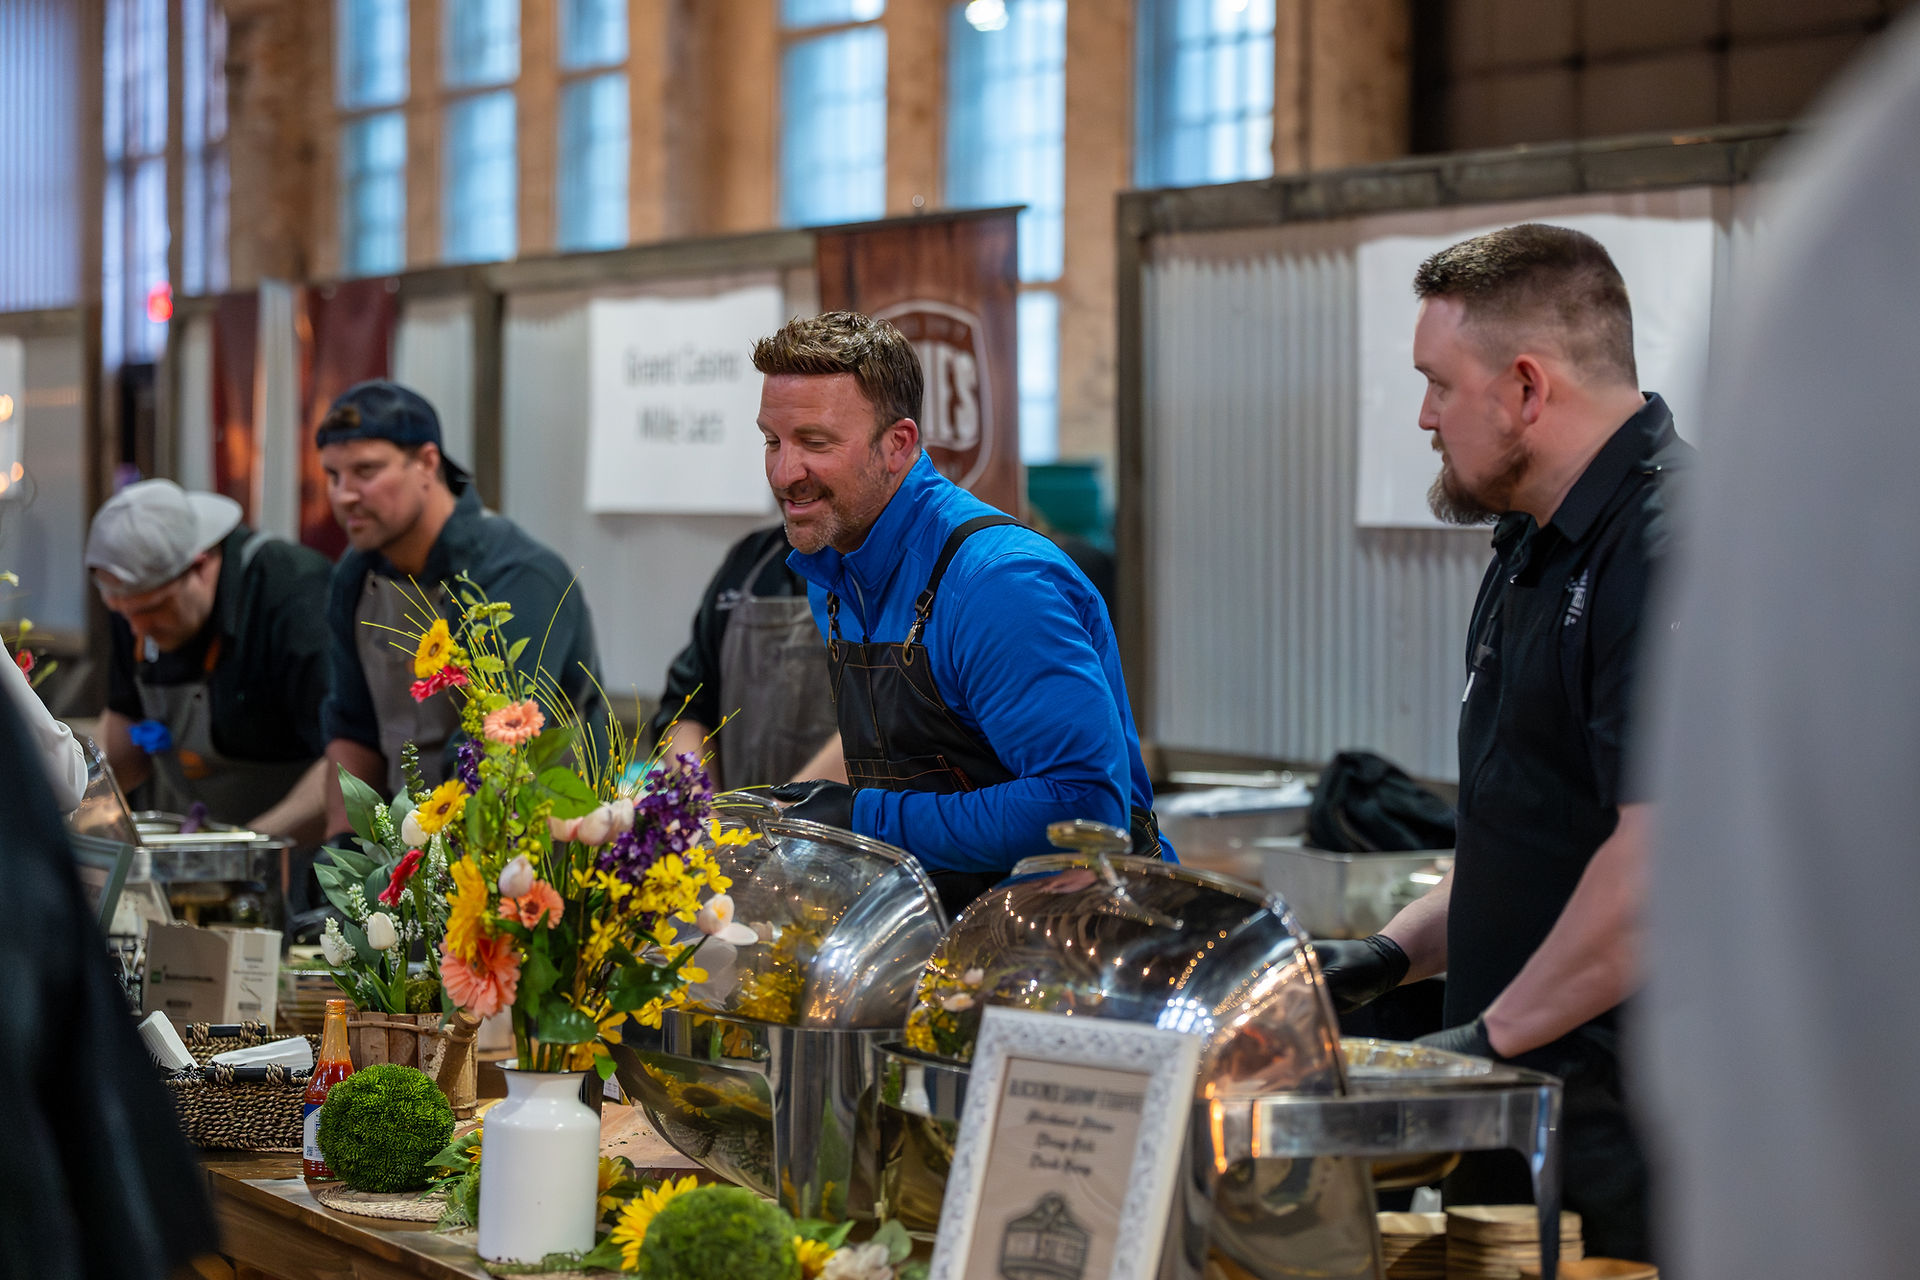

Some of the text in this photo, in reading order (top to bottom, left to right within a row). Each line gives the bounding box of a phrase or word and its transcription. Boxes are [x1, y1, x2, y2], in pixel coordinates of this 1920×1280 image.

[622, 342, 741, 387] Grand Casino
[637, 404, 679, 443] Mille
